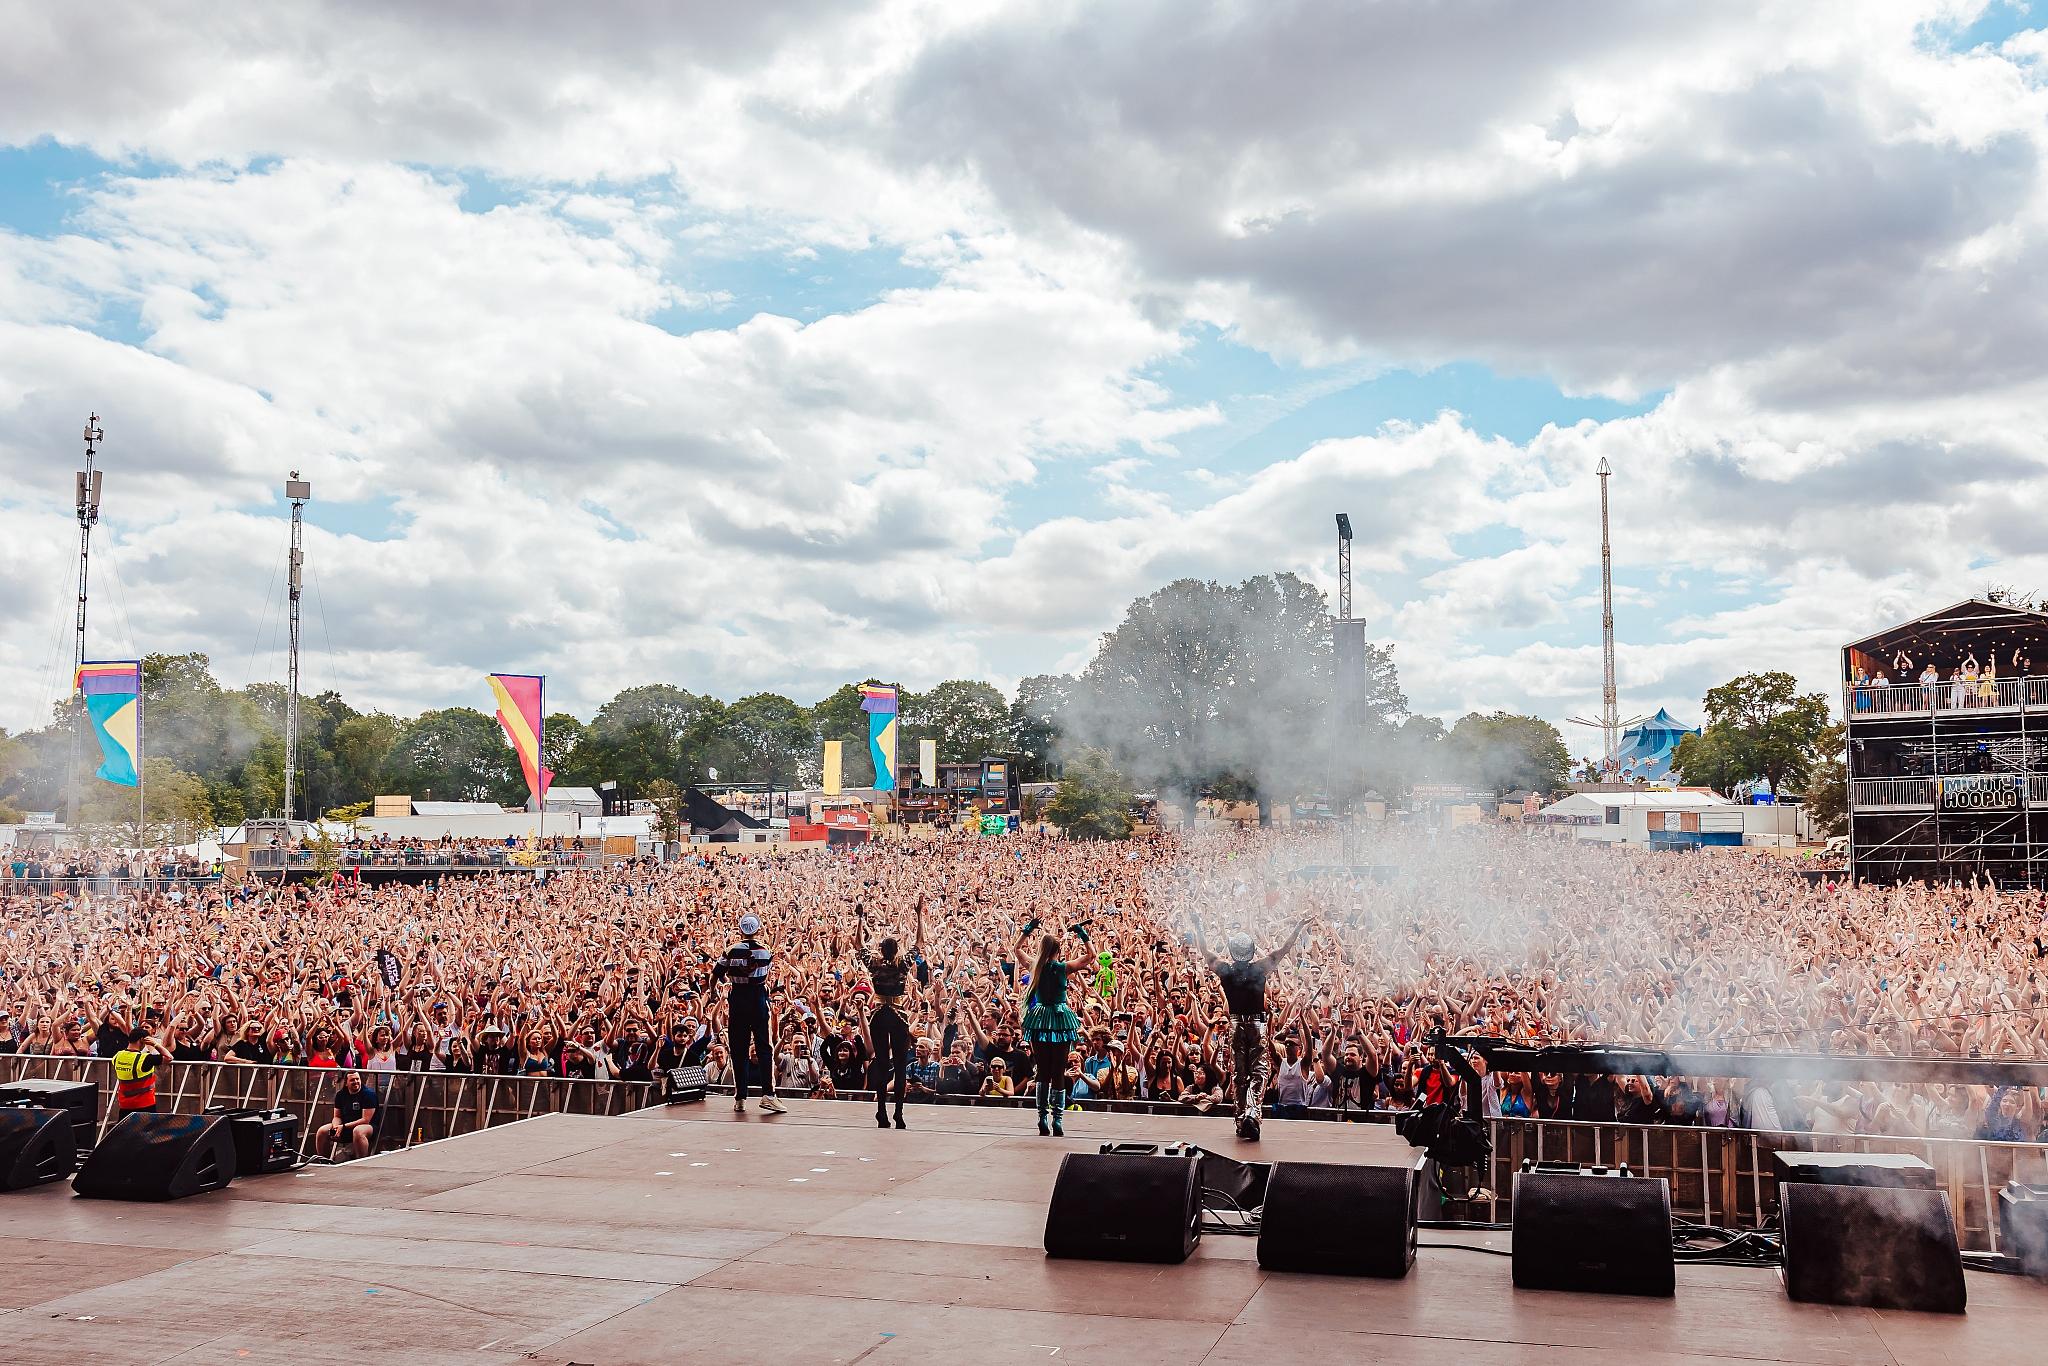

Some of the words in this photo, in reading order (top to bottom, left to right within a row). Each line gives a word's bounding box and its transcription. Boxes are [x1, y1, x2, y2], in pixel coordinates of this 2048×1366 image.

[1944, 775, 2015, 792] MIGHTY
[1944, 791, 2016, 808] HOOPLA
[384, 954, 396, 986] PLEASE
[390, 957, 400, 982] BITCH
